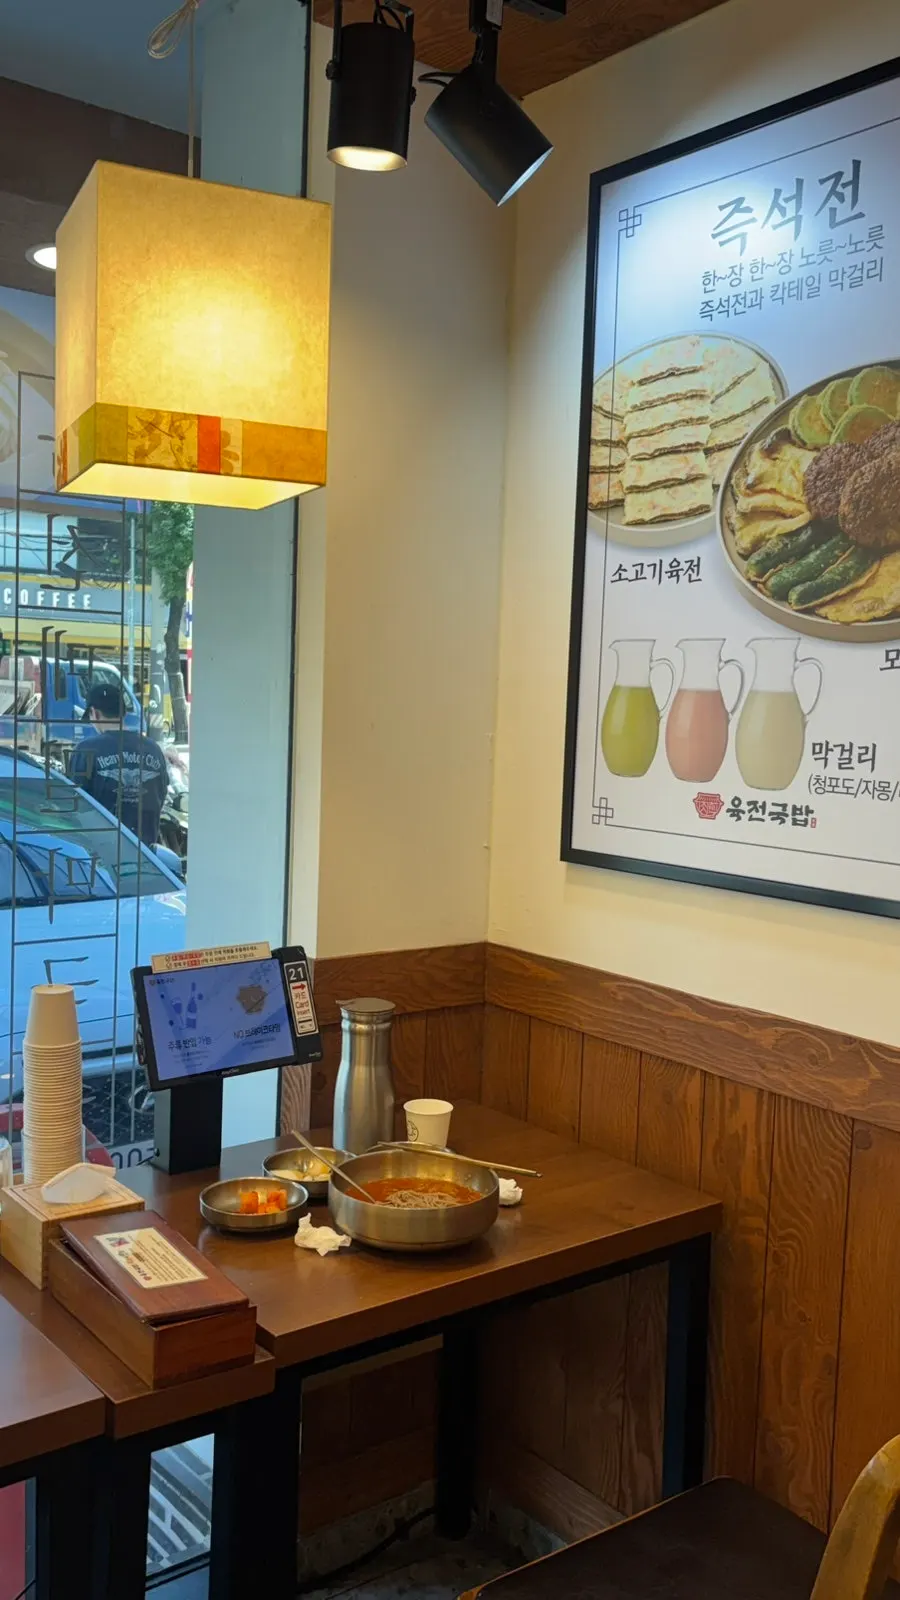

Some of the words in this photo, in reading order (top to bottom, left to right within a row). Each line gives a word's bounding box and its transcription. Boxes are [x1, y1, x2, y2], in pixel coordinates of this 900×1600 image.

[710, 159, 866, 256] 즉석전
[701, 263, 744, 294] 한~장
[749, 249, 793, 282] 한~장
[798, 224, 885, 268] 노릇~노릇
[699, 287, 764, 322] 즉석전과
[770, 271, 821, 305] 칵테일
[828, 256, 884, 290] 막걸리
[610, 555, 703, 586] 소고기육전
[3, 587, 92, 610] COFFEE
[145, 754, 161, 770] Club
[811, 739, 877, 774] 막걸리
[808, 773, 900, 802] (청포도/자몽/
[725, 795, 815, 827] 육전국밥
[288, 967, 304, 981] 21
[294, 991, 307, 1000] 카드
[295, 1001, 309, 1009] Card
[245, 1023, 281, 1038] 브레이크타임
[167, 1038, 182, 1050] 주류
